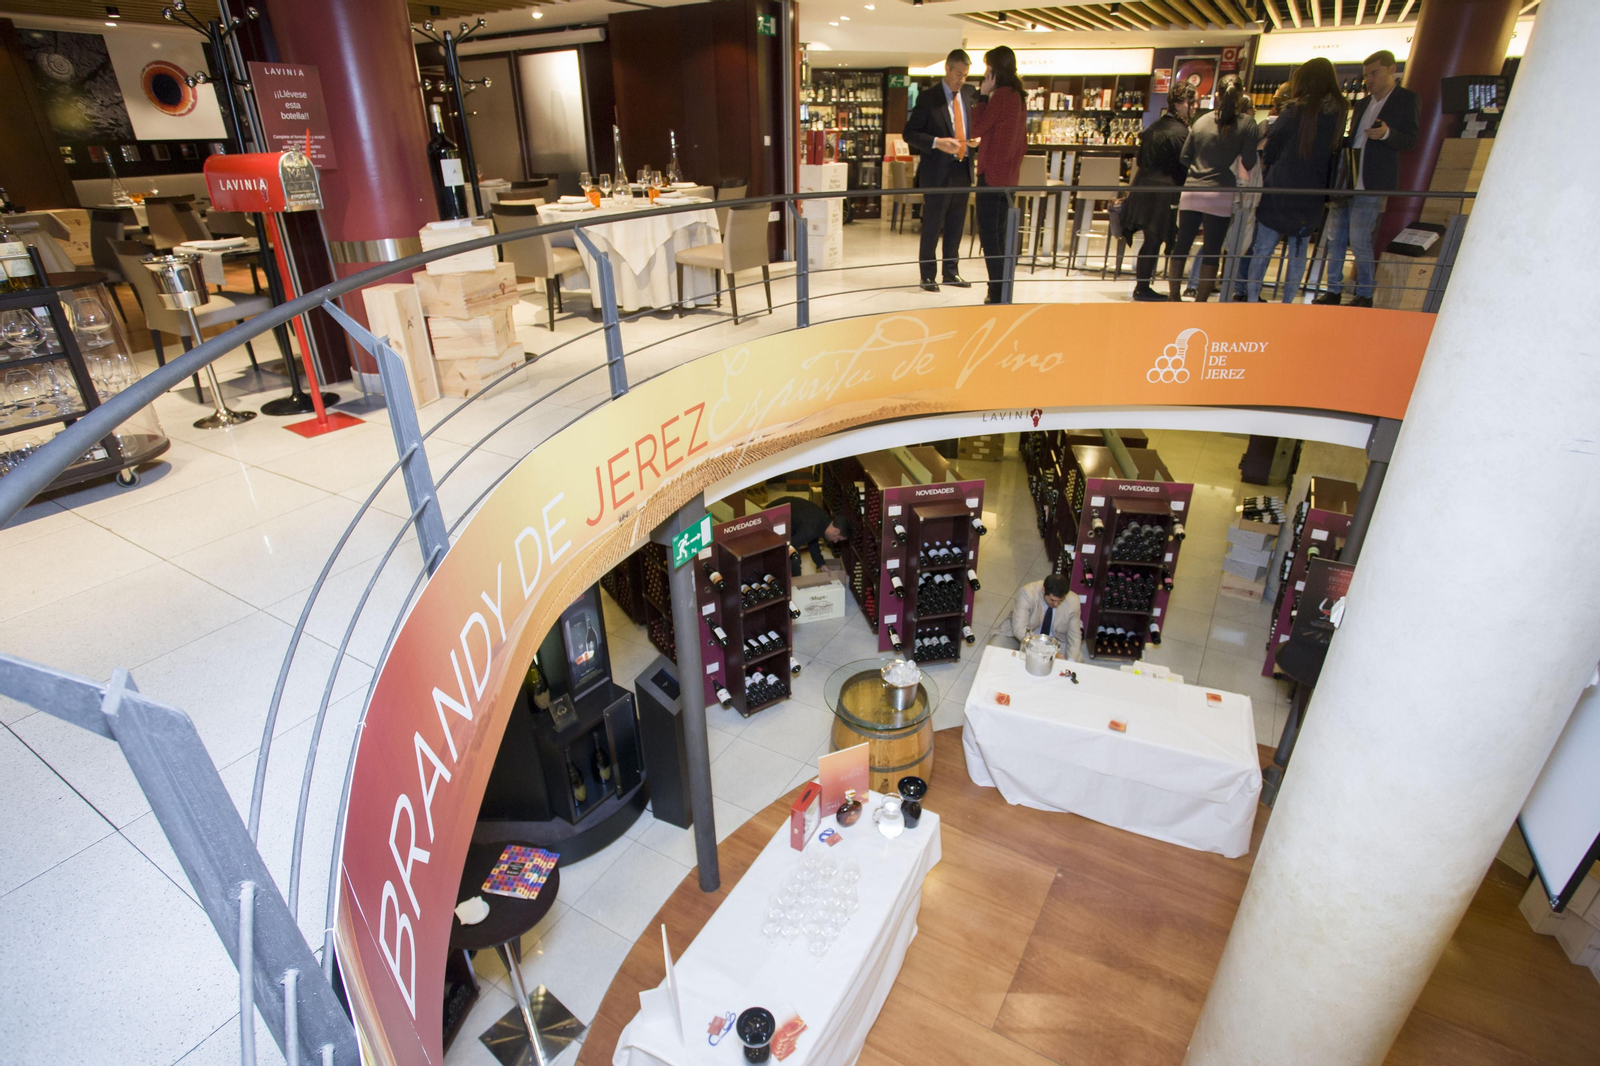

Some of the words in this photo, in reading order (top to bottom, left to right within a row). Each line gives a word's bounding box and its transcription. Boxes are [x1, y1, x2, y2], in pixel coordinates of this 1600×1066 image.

[264, 67, 305, 77] LAVINIA
[284, 102, 301, 110] esta
[286, 167, 310, 179] MAIL
[219, 179, 267, 191] LAVINIA
[955, 303, 1068, 390] Vino
[1210, 341, 1269, 353] BRANDY
[1208, 355, 1227, 366] DE
[1205, 368, 1245, 379] JEREZ
[982, 409, 1041, 422] LAVINIA
[915, 487, 955, 496] NOVEDADES
[1118, 484, 1160, 493] NOVEDADES
[723, 517, 762, 534] NOVEDADES
[379, 561, 507, 1020] BRANDY
[514, 491, 572, 600] DE
[586, 401, 708, 526] JEREZ
